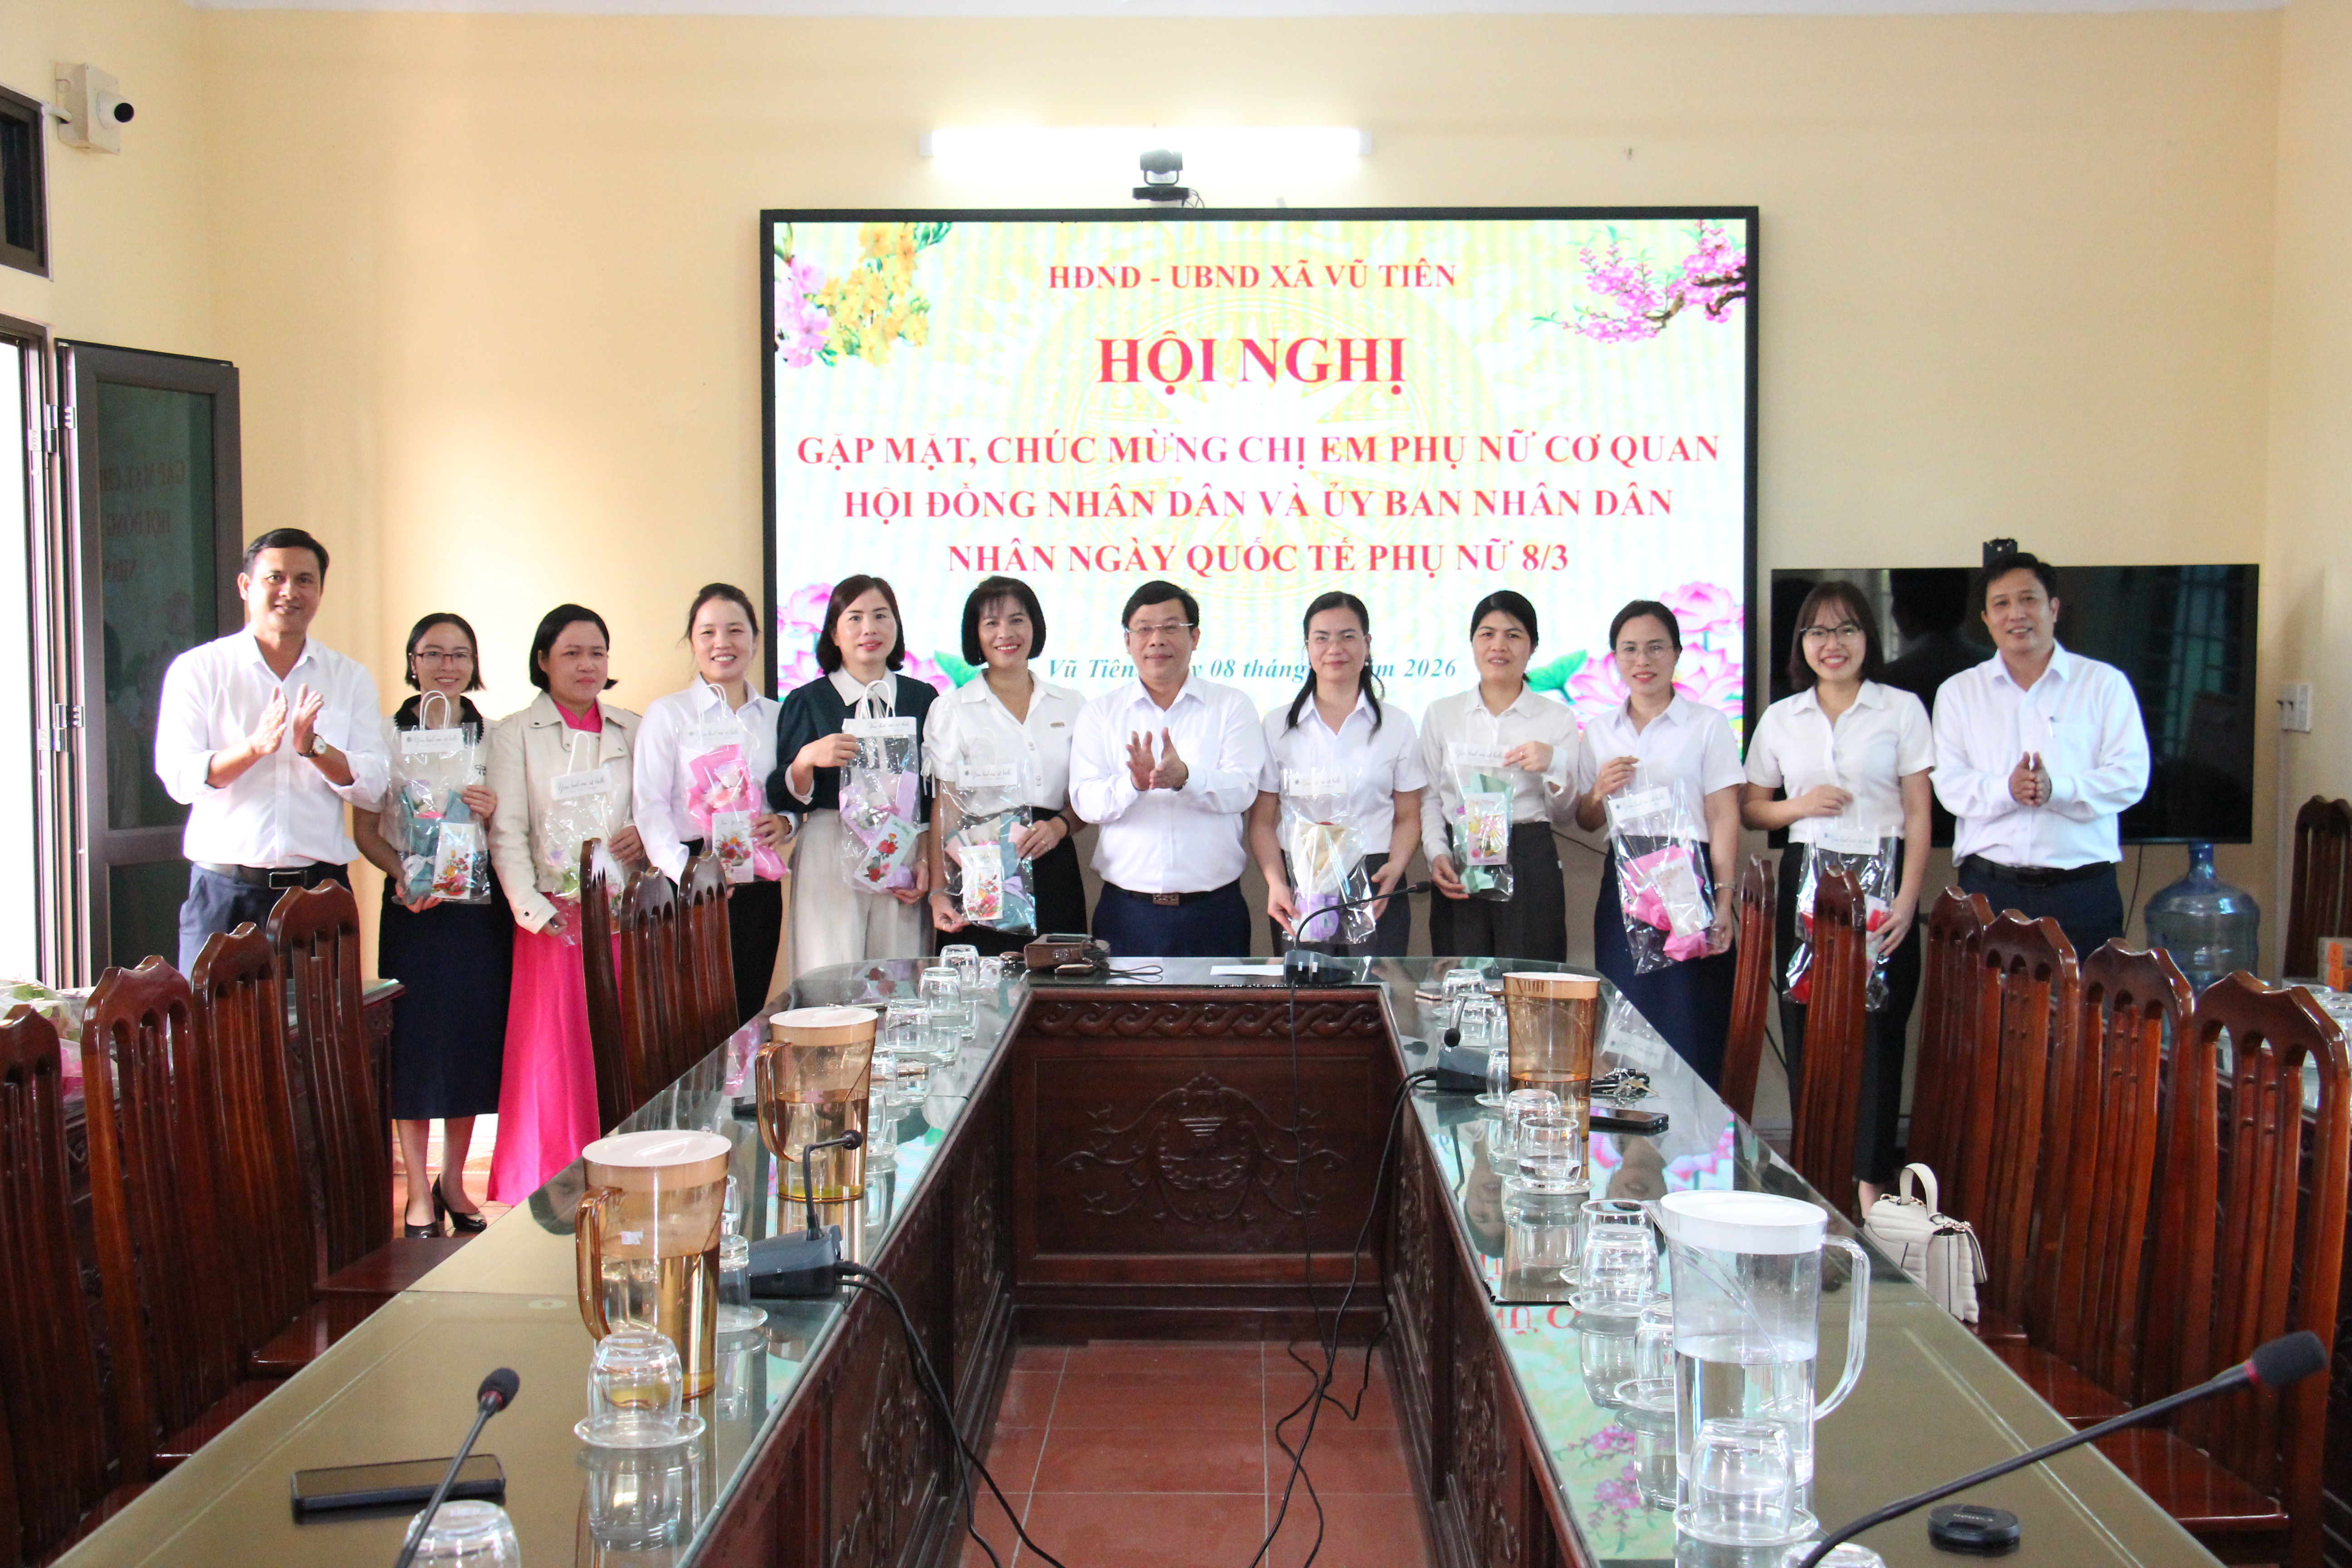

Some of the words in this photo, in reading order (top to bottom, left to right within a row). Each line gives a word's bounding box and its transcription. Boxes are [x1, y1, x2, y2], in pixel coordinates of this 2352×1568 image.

[1050, 266, 1141, 288] HĐND
[1171, 266, 1259, 288] UBND
[1271, 260, 1313, 288] XÃ
[1325, 259, 1367, 288] VŨ
[1379, 258, 1455, 287] TIÊN
[1097, 330, 1217, 395] HỘI
[1238, 338, 1406, 395] NGHỊ
[988, 429, 1095, 463] CHÚC
[1109, 429, 1227, 463] MỪNG
[1239, 436, 1304, 470] CHỊ
[1322, 437, 1377, 462] EM
[1391, 436, 1465, 470] PHỤ
[1479, 429, 1536, 462] NỮ
[1545, 434, 1600, 462] CƠ
[1611, 436, 1718, 468] QUAN
[845, 487, 912, 525] HỘI
[1048, 483, 1154, 517] NHÂN
[1169, 483, 1245, 517] DÂN
[1259, 483, 1309, 516] VÀ
[1324, 482, 1373, 517] ỦY
[1386, 490, 1460, 516] BAN
[1474, 482, 1580, 516] NHÂN
[1595, 482, 1671, 515] DÂN
[949, 538, 1055, 571] NHÂN
[1069, 537, 1176, 572] NGÀY
[1187, 537, 1297, 578] QUỐC
[1308, 537, 1354, 571] TẾ
[1369, 545, 1443, 578] PHỤ
[1457, 538, 1513, 571] NỮ
[1523, 544, 1567, 571] 8/3
[1049, 659, 1077, 678] Vũ
[1210, 659, 1235, 678] 08
[1243, 659, 1307, 683] tháng
[1403, 659, 1456, 677] 2026
